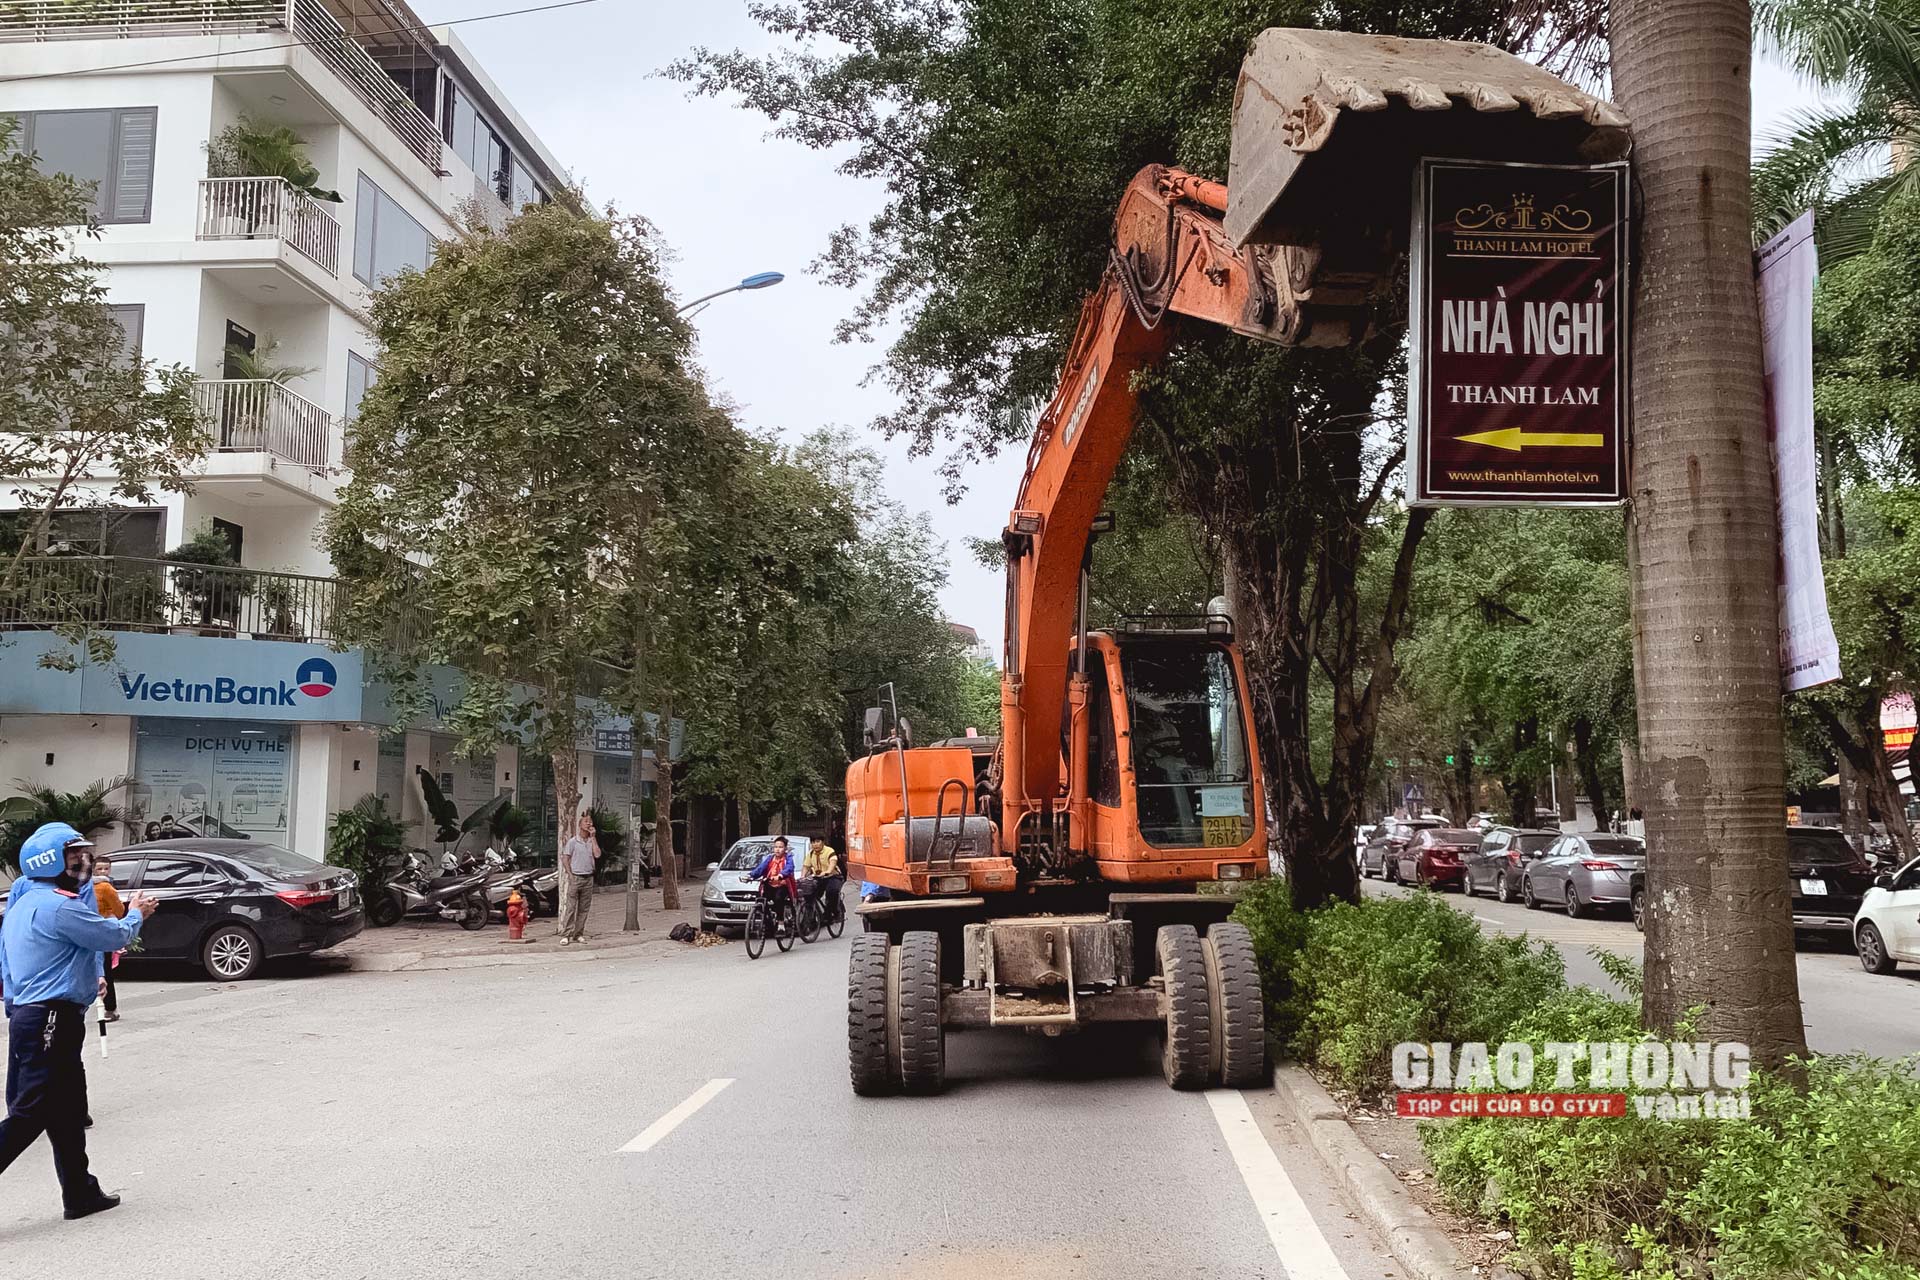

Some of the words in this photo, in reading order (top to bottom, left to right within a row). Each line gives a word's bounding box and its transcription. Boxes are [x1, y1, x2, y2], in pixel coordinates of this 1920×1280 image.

[1454, 240, 1507, 251] THANH
[1511, 241, 1542, 252] LAM
[1547, 242, 1594, 253] HOTEL
[1442, 286, 1513, 354] NHÀ
[1524, 279, 1604, 356] NGHỈ
[1447, 385, 1536, 404] THANH
[1543, 387, 1600, 405] LAM
[1448, 471, 1599, 483] www.thanhlamhotel.vn
[118, 672, 297, 706] VietinBank
[185, 737, 226, 753] DỊCH
[231, 738, 252, 754] VỤ
[26, 849, 56, 870] TTGT
